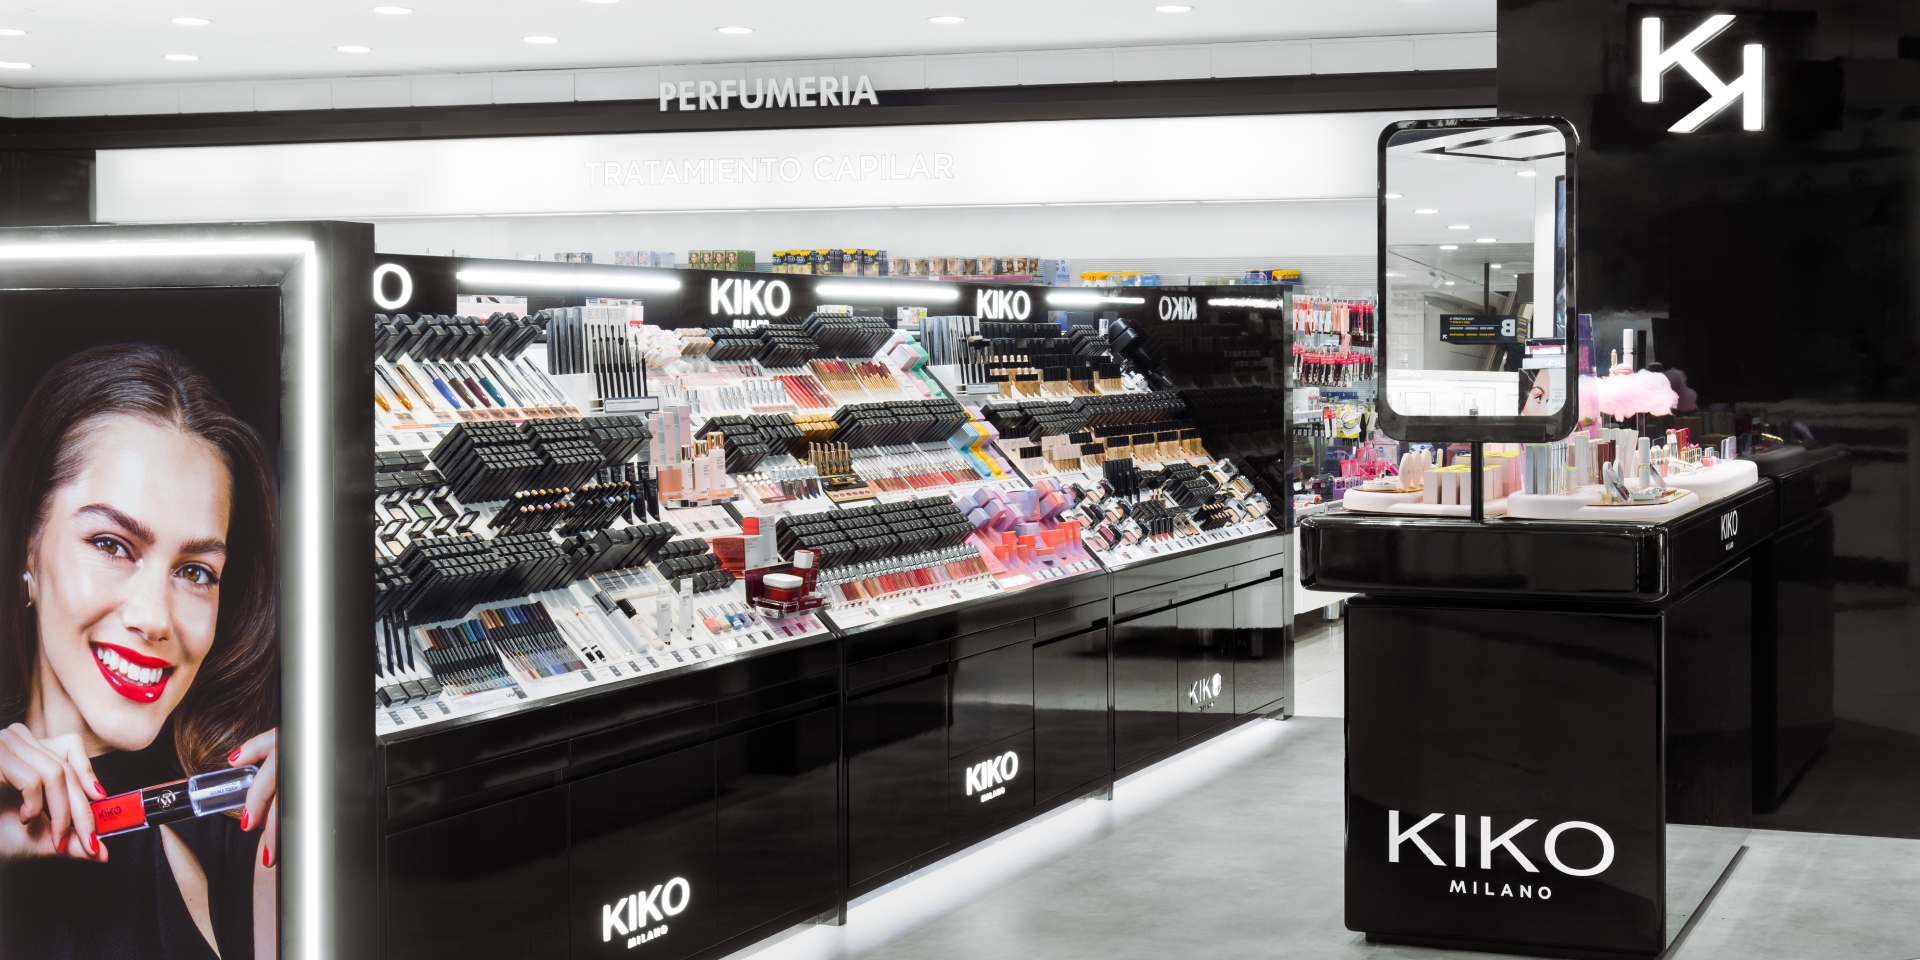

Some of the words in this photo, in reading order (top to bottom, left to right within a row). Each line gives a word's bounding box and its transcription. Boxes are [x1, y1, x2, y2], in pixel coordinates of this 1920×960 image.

[658, 74, 879, 112] PERFUMERIA
[583, 155, 802, 187] TRATAMIENTO
[812, 152, 955, 182] CAPILAR
[710, 277, 791, 317] KIKO
[976, 288, 1031, 320] KIKO
[1720, 509, 1739, 541] KIKO
[1189, 672, 1222, 706] KIKO
[965, 750, 1019, 796] KIKO
[97, 805, 122, 819] KIKO
[1388, 809, 1615, 877] KIKO
[1449, 879, 1552, 900] MILANO
[602, 876, 691, 942] KIKO
[627, 924, 669, 949] MILANO
